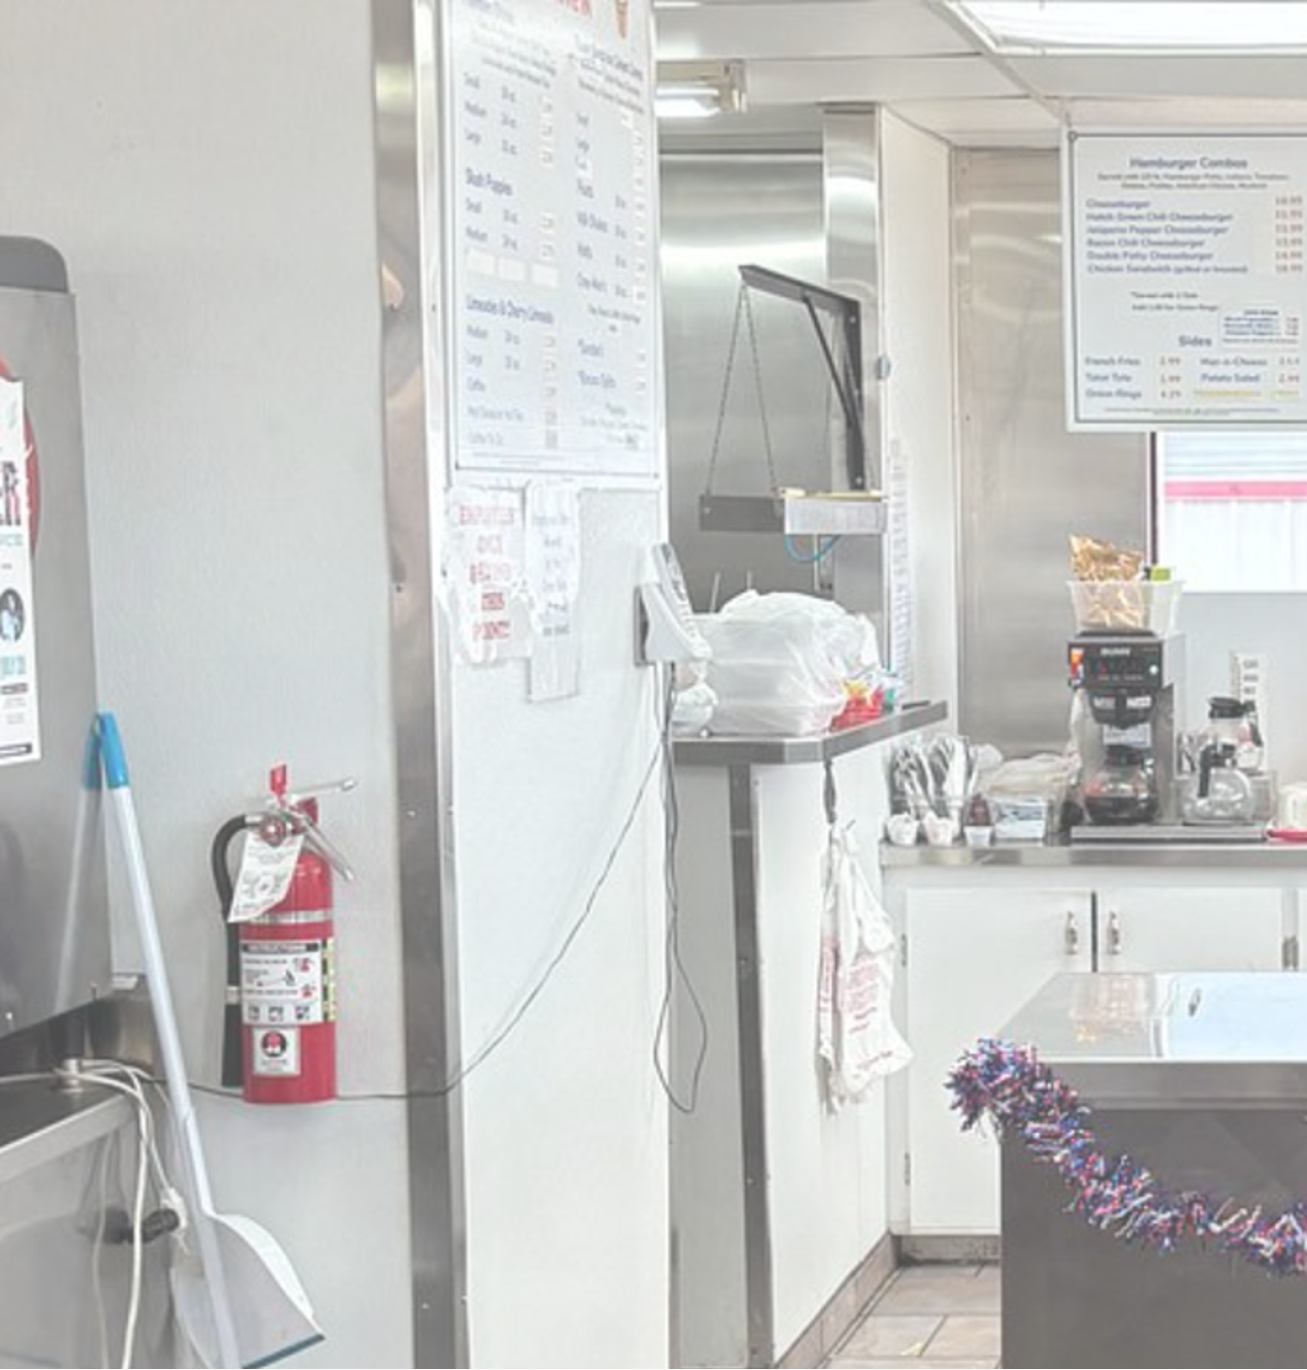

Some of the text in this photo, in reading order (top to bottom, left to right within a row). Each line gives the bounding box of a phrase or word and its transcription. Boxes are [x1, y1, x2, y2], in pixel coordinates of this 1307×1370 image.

[1130, 158, 1248, 168] Hamburger Combos
[1086, 199, 1150, 209] Cheeseburger
[1170, 213, 1233, 222] Cheeseburger
[1164, 226, 1228, 235] Cheeseburger
[1141, 238, 1205, 248] Cheeseburger
[1150, 251, 1214, 261] Cheeseburger
[1179, 335, 1212, 347] Sides
